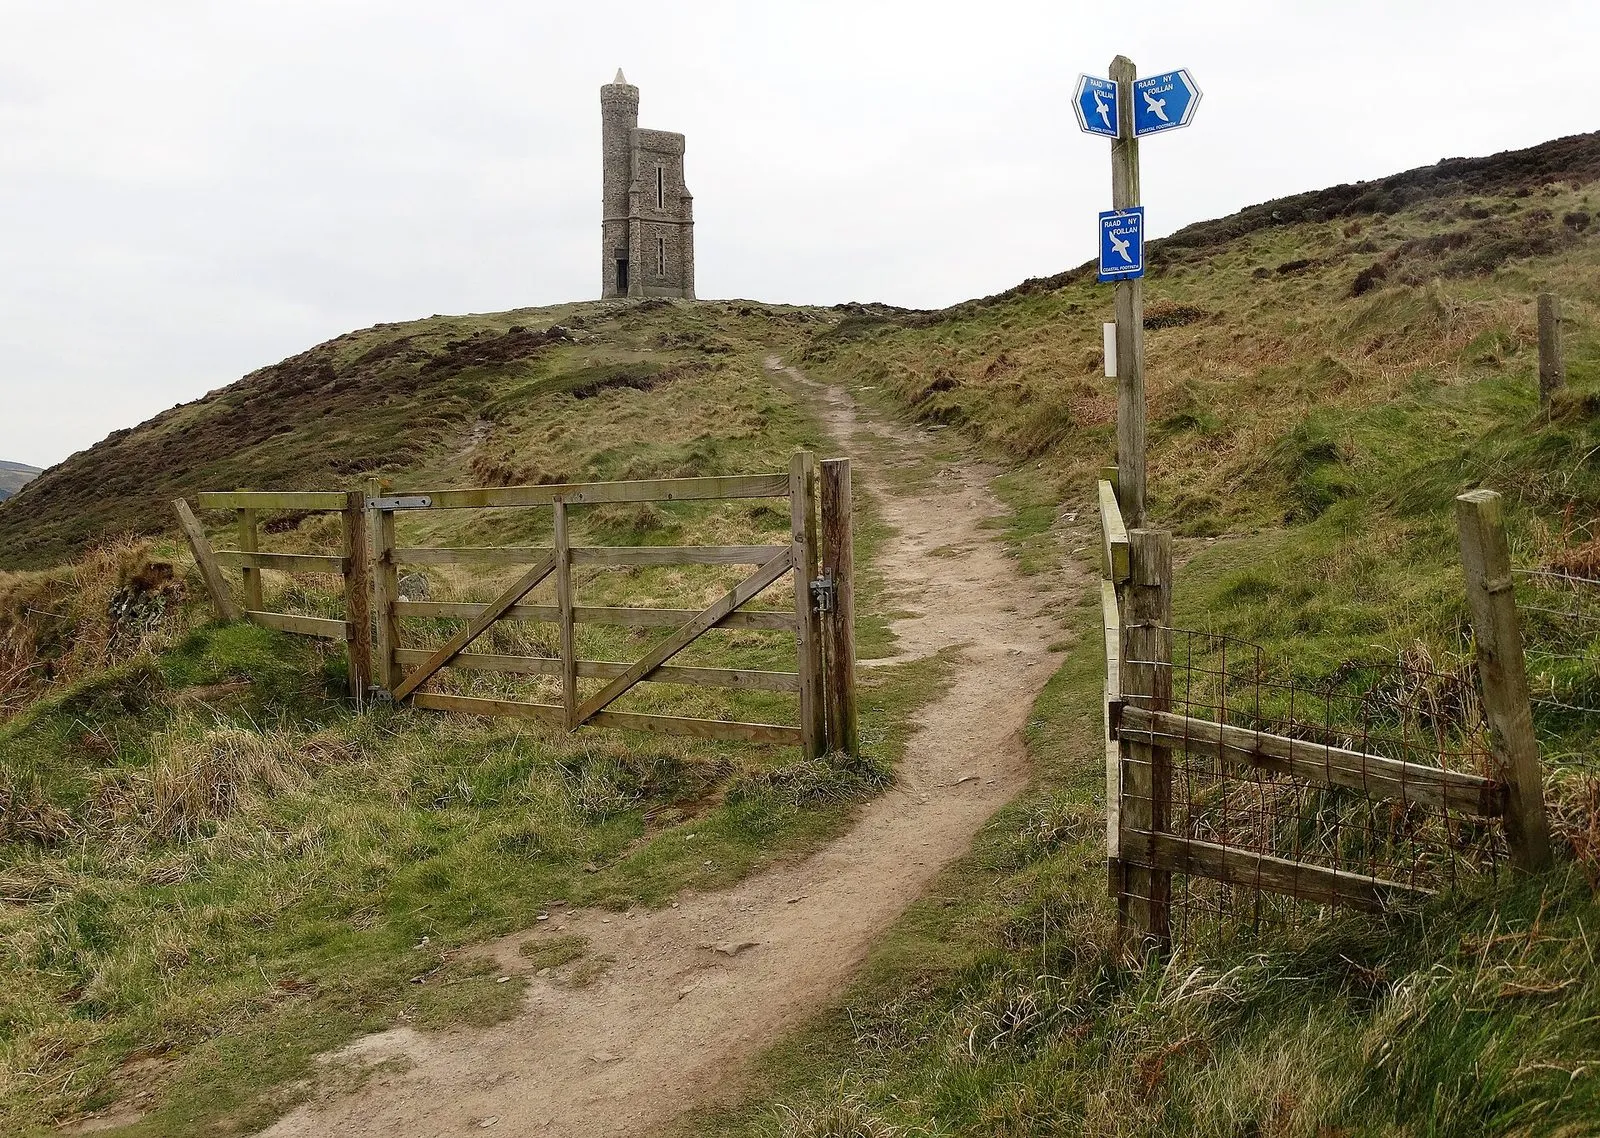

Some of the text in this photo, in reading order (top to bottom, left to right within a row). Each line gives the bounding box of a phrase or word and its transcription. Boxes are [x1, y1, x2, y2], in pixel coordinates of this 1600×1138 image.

[1138, 74, 1172, 89] RAAD NY
[1097, 90, 1114, 99] FOILLAN
[1147, 84, 1173, 95] FOILLAN
[1156, 121, 1177, 129] FOOTPATH
[1104, 217, 1137, 228] RAAD NY
[1113, 226, 1138, 235] FOILLAN
